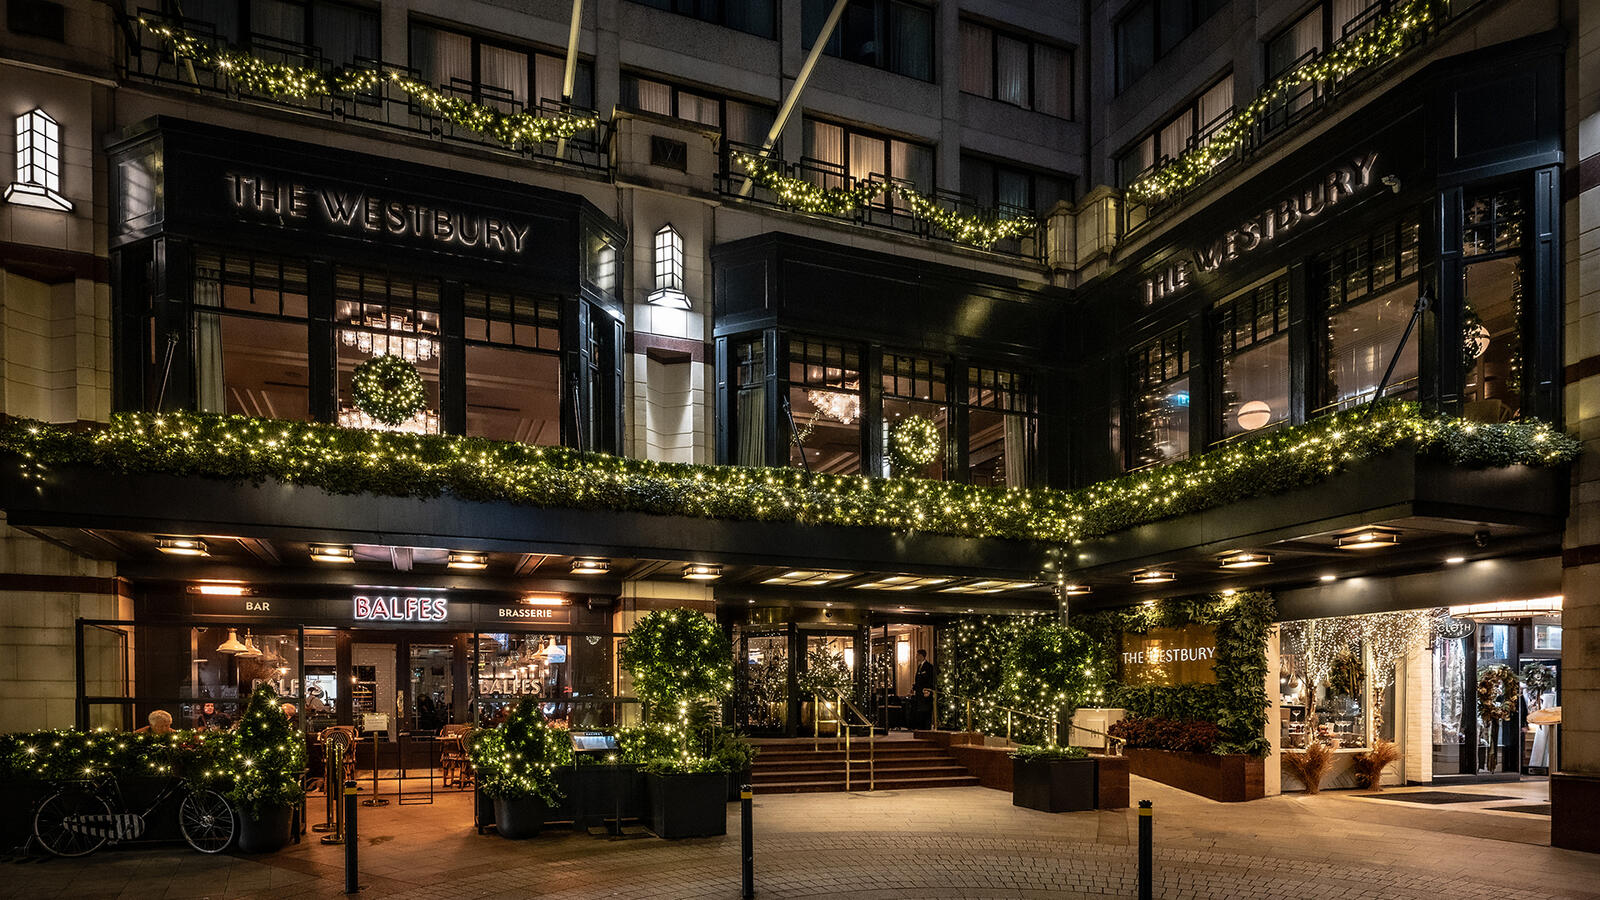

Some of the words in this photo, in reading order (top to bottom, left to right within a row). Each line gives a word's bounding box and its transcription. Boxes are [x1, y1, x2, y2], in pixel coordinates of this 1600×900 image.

[224, 175, 308, 219] THE
[320, 190, 529, 252] WESTBURY
[1143, 259, 1193, 305] THE
[1193, 151, 1380, 272] WESTBURY
[245, 601, 271, 612] BAR
[354, 595, 449, 622] BALFES
[498, 608, 553, 619] BRASSERIE
[1122, 651, 1144, 664] THE
[1148, 646, 1216, 663] ESTBURY
[479, 678, 542, 695] BALFES
